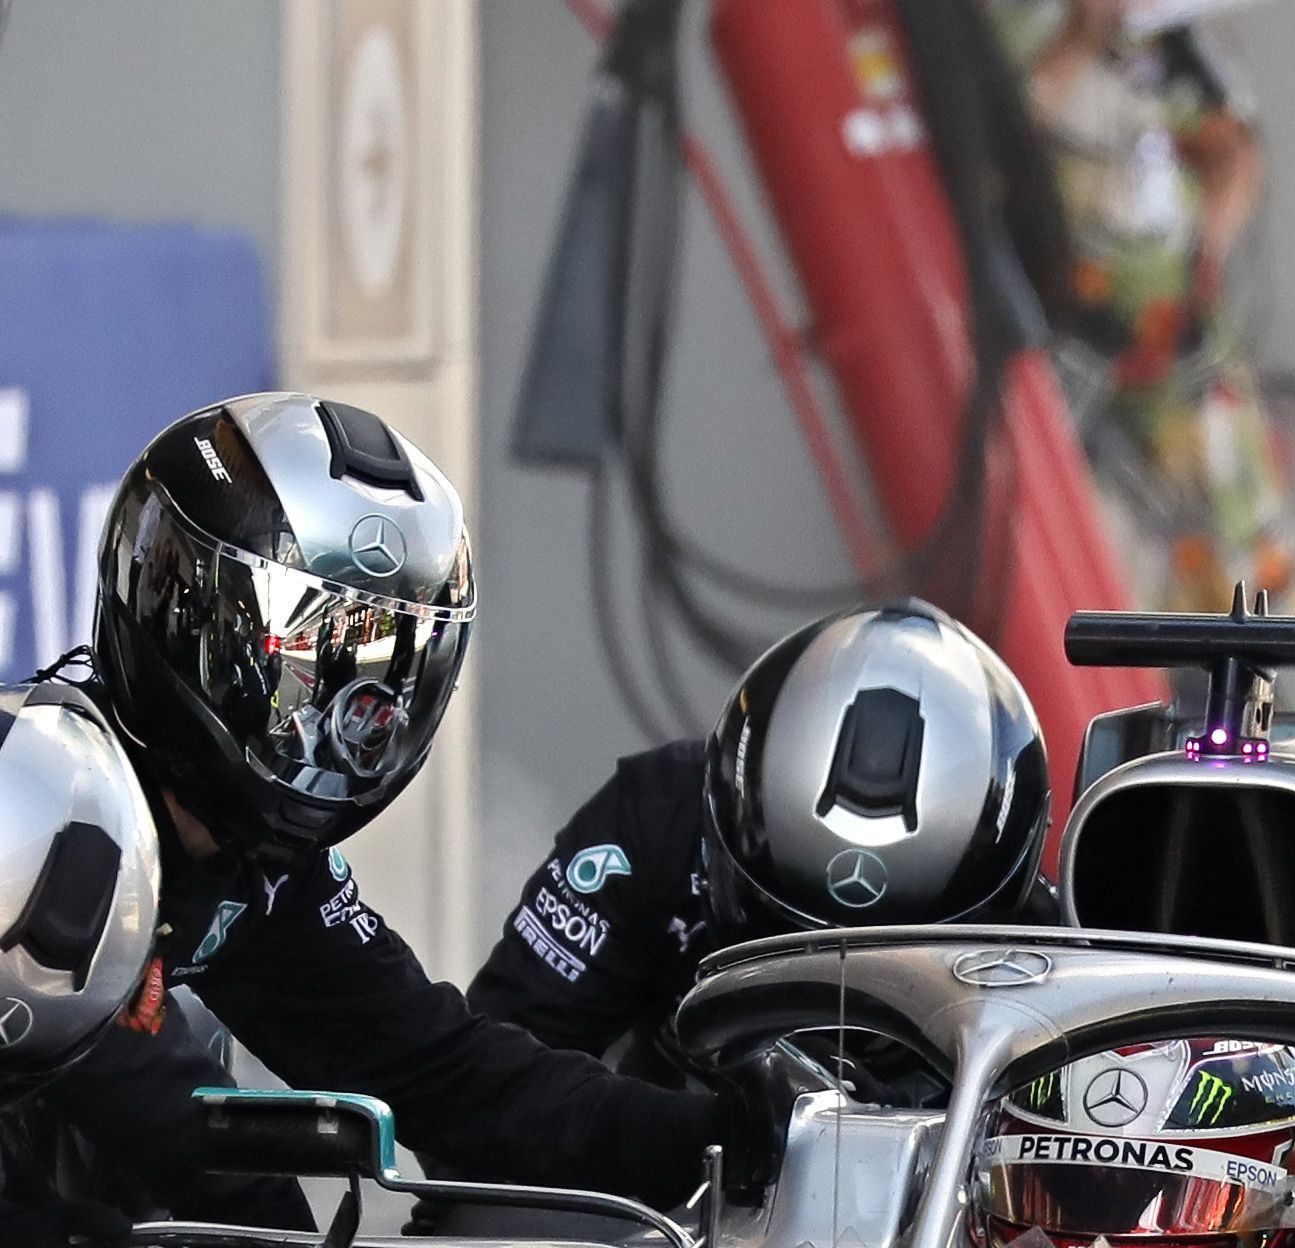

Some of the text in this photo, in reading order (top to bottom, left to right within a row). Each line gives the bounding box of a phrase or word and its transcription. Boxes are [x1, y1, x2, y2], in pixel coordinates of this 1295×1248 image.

[194, 436, 233, 485] BOSE
[535, 886, 608, 956] EPSON
[1018, 1136, 1194, 1172] PETRONAS
[1226, 1160, 1277, 1187] EPSON
